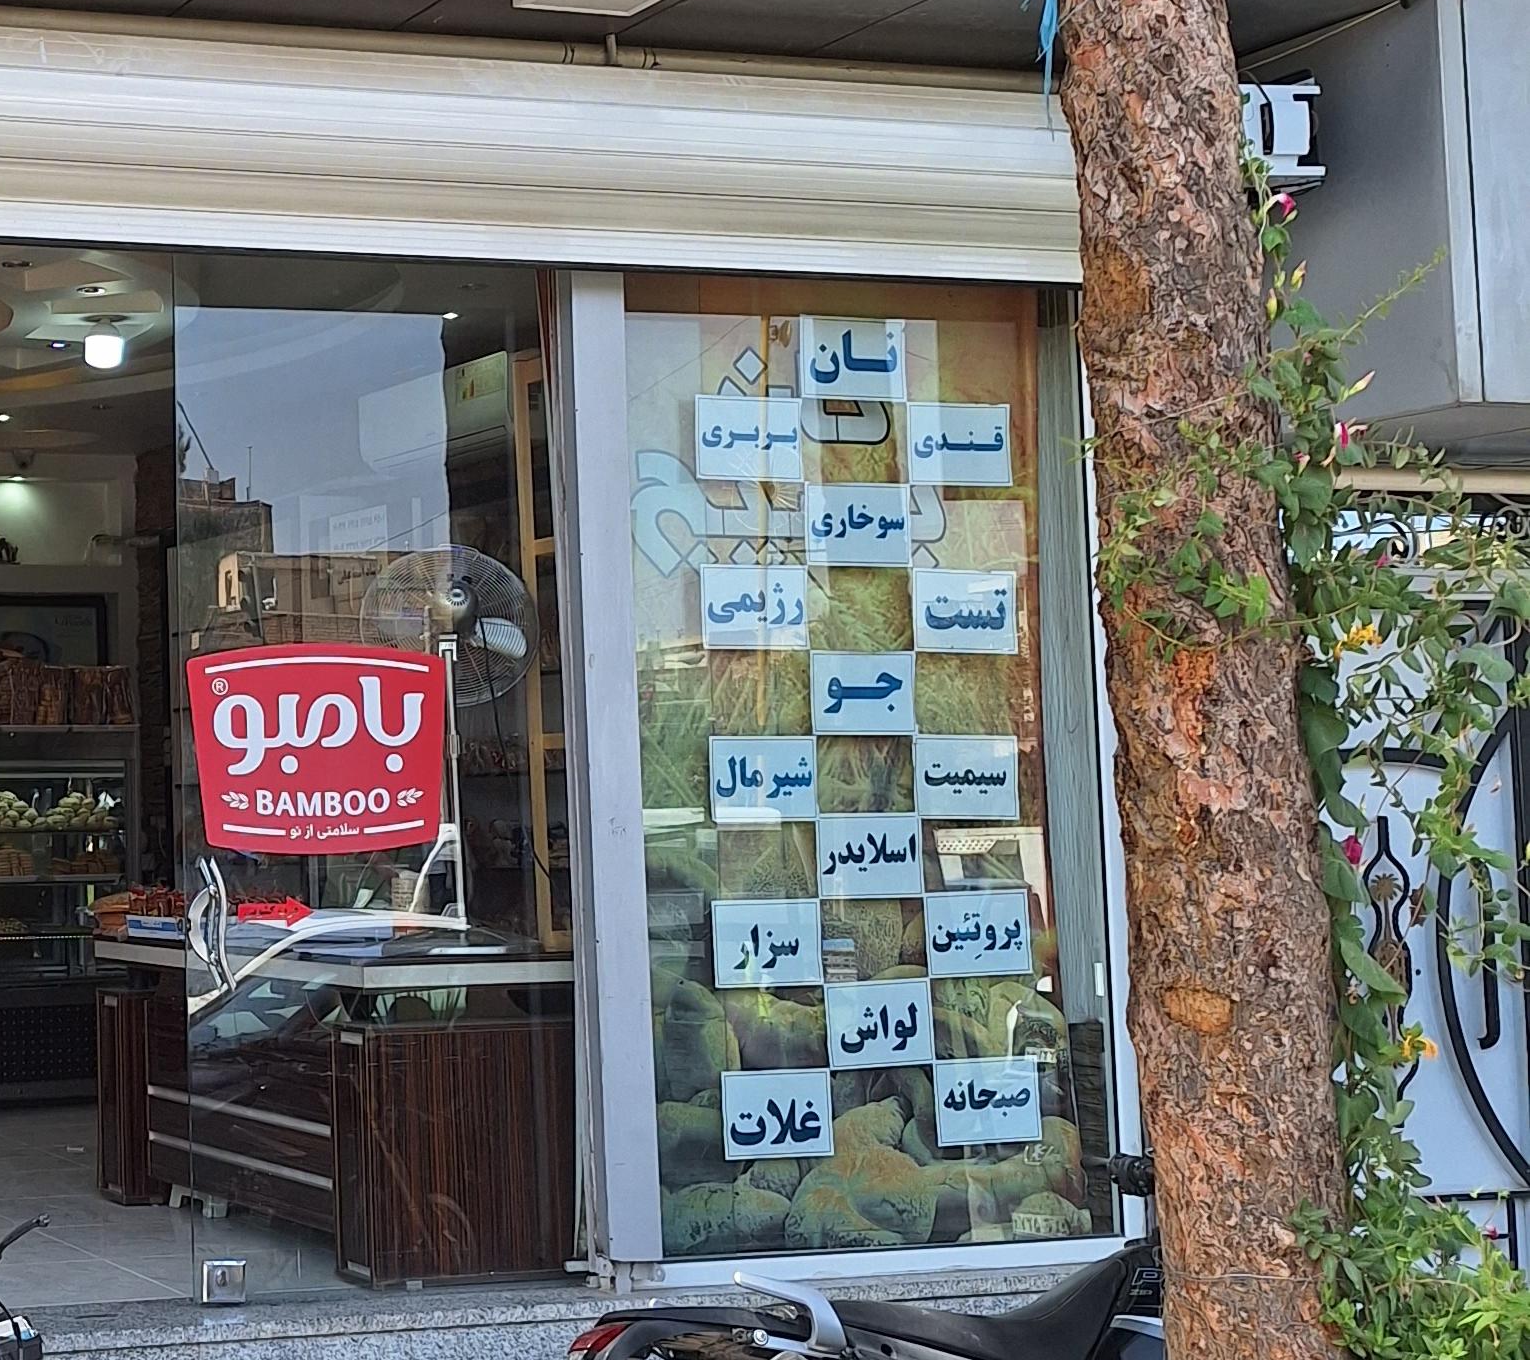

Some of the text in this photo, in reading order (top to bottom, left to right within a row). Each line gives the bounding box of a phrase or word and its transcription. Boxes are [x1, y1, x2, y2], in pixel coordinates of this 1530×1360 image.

[810, 329, 898, 384] نان
[702, 425, 799, 450] بربری
[914, 426, 1004, 458] قندی
[811, 504, 905, 538] سوخاری
[707, 583, 804, 626] رژیمی
[924, 588, 1008, 631] تست
[823, 672, 904, 714] جو
[213, 676, 425, 775] بامبو
[924, 763, 1007, 795] سیمیت
[256, 788, 391, 817] BAMBOO
[290, 823, 360, 840] سلامتی از نو
[822, 833, 917, 875] اسلایدر
[734, 924, 799, 969] سزار
[840, 1002, 918, 1053] لواش
[944, 1080, 1031, 1117] صبحانه
[730, 1098, 821, 1146] غلات
